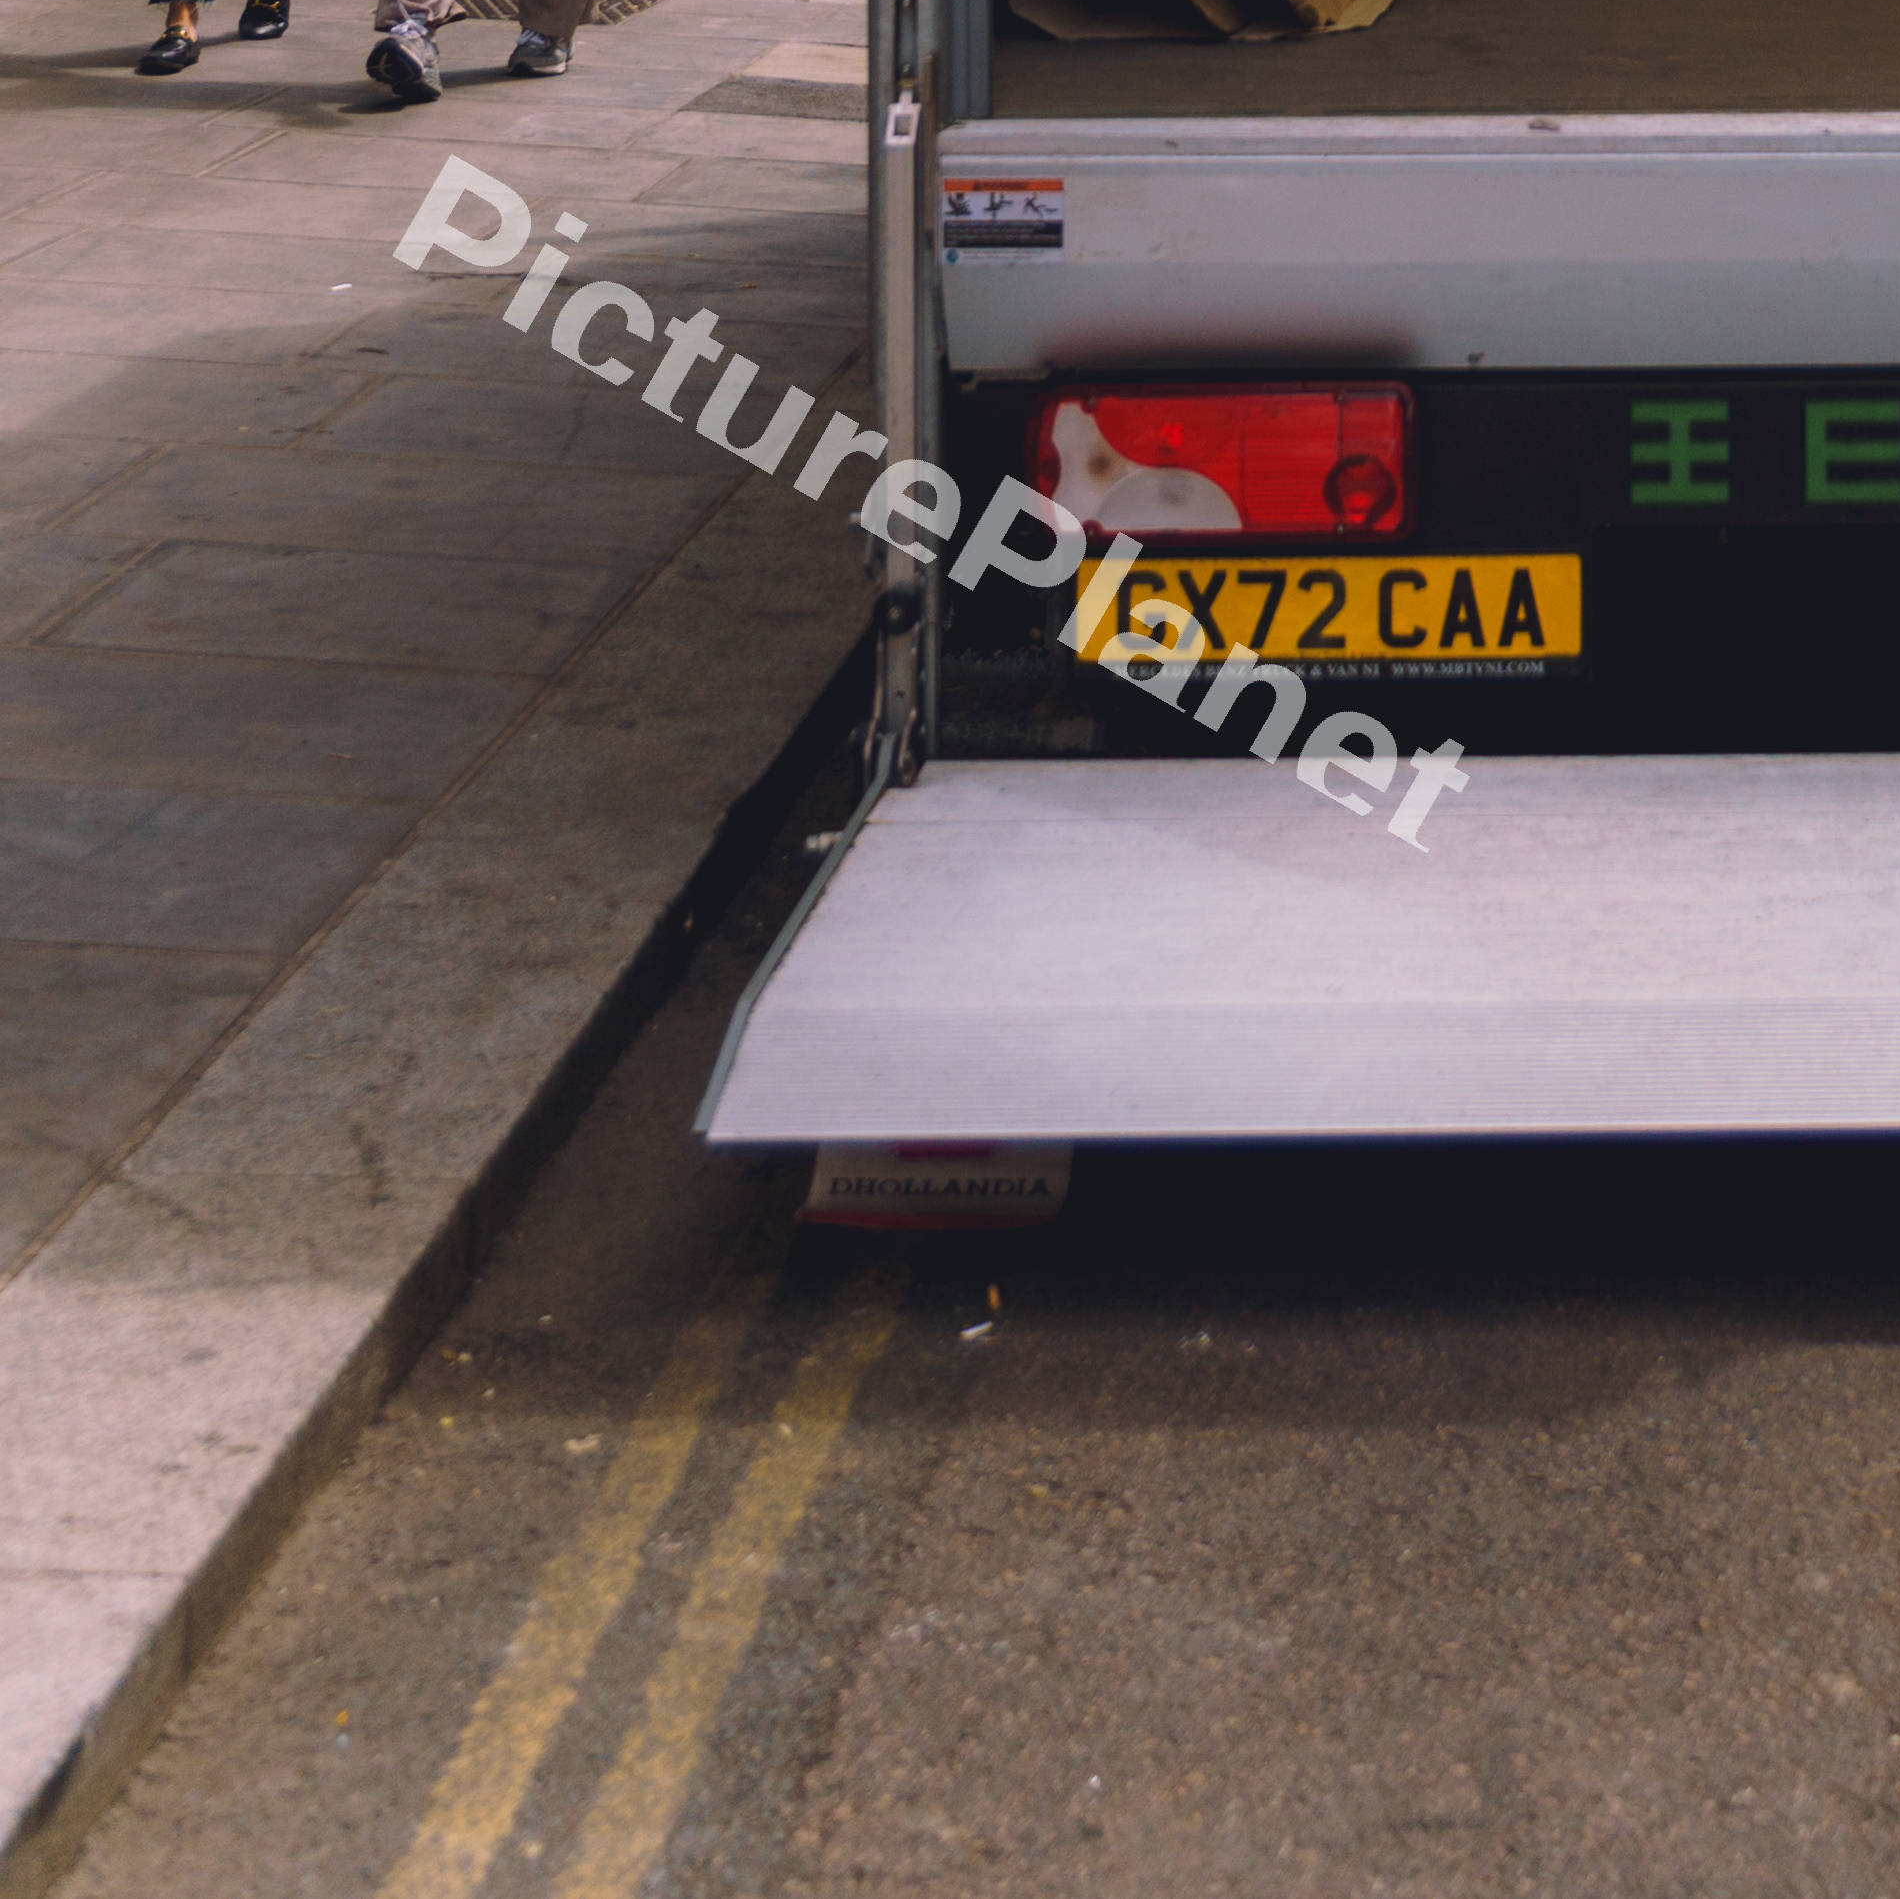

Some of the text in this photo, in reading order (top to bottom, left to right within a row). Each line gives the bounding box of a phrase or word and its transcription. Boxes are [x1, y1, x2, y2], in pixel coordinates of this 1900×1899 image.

[1115, 566, 1547, 652] GX72 CAA
[1310, 663, 1323, 676] &
[1326, 663, 1358, 676] VAN
[828, 1176, 1050, 1197] DHOLLANDIA
